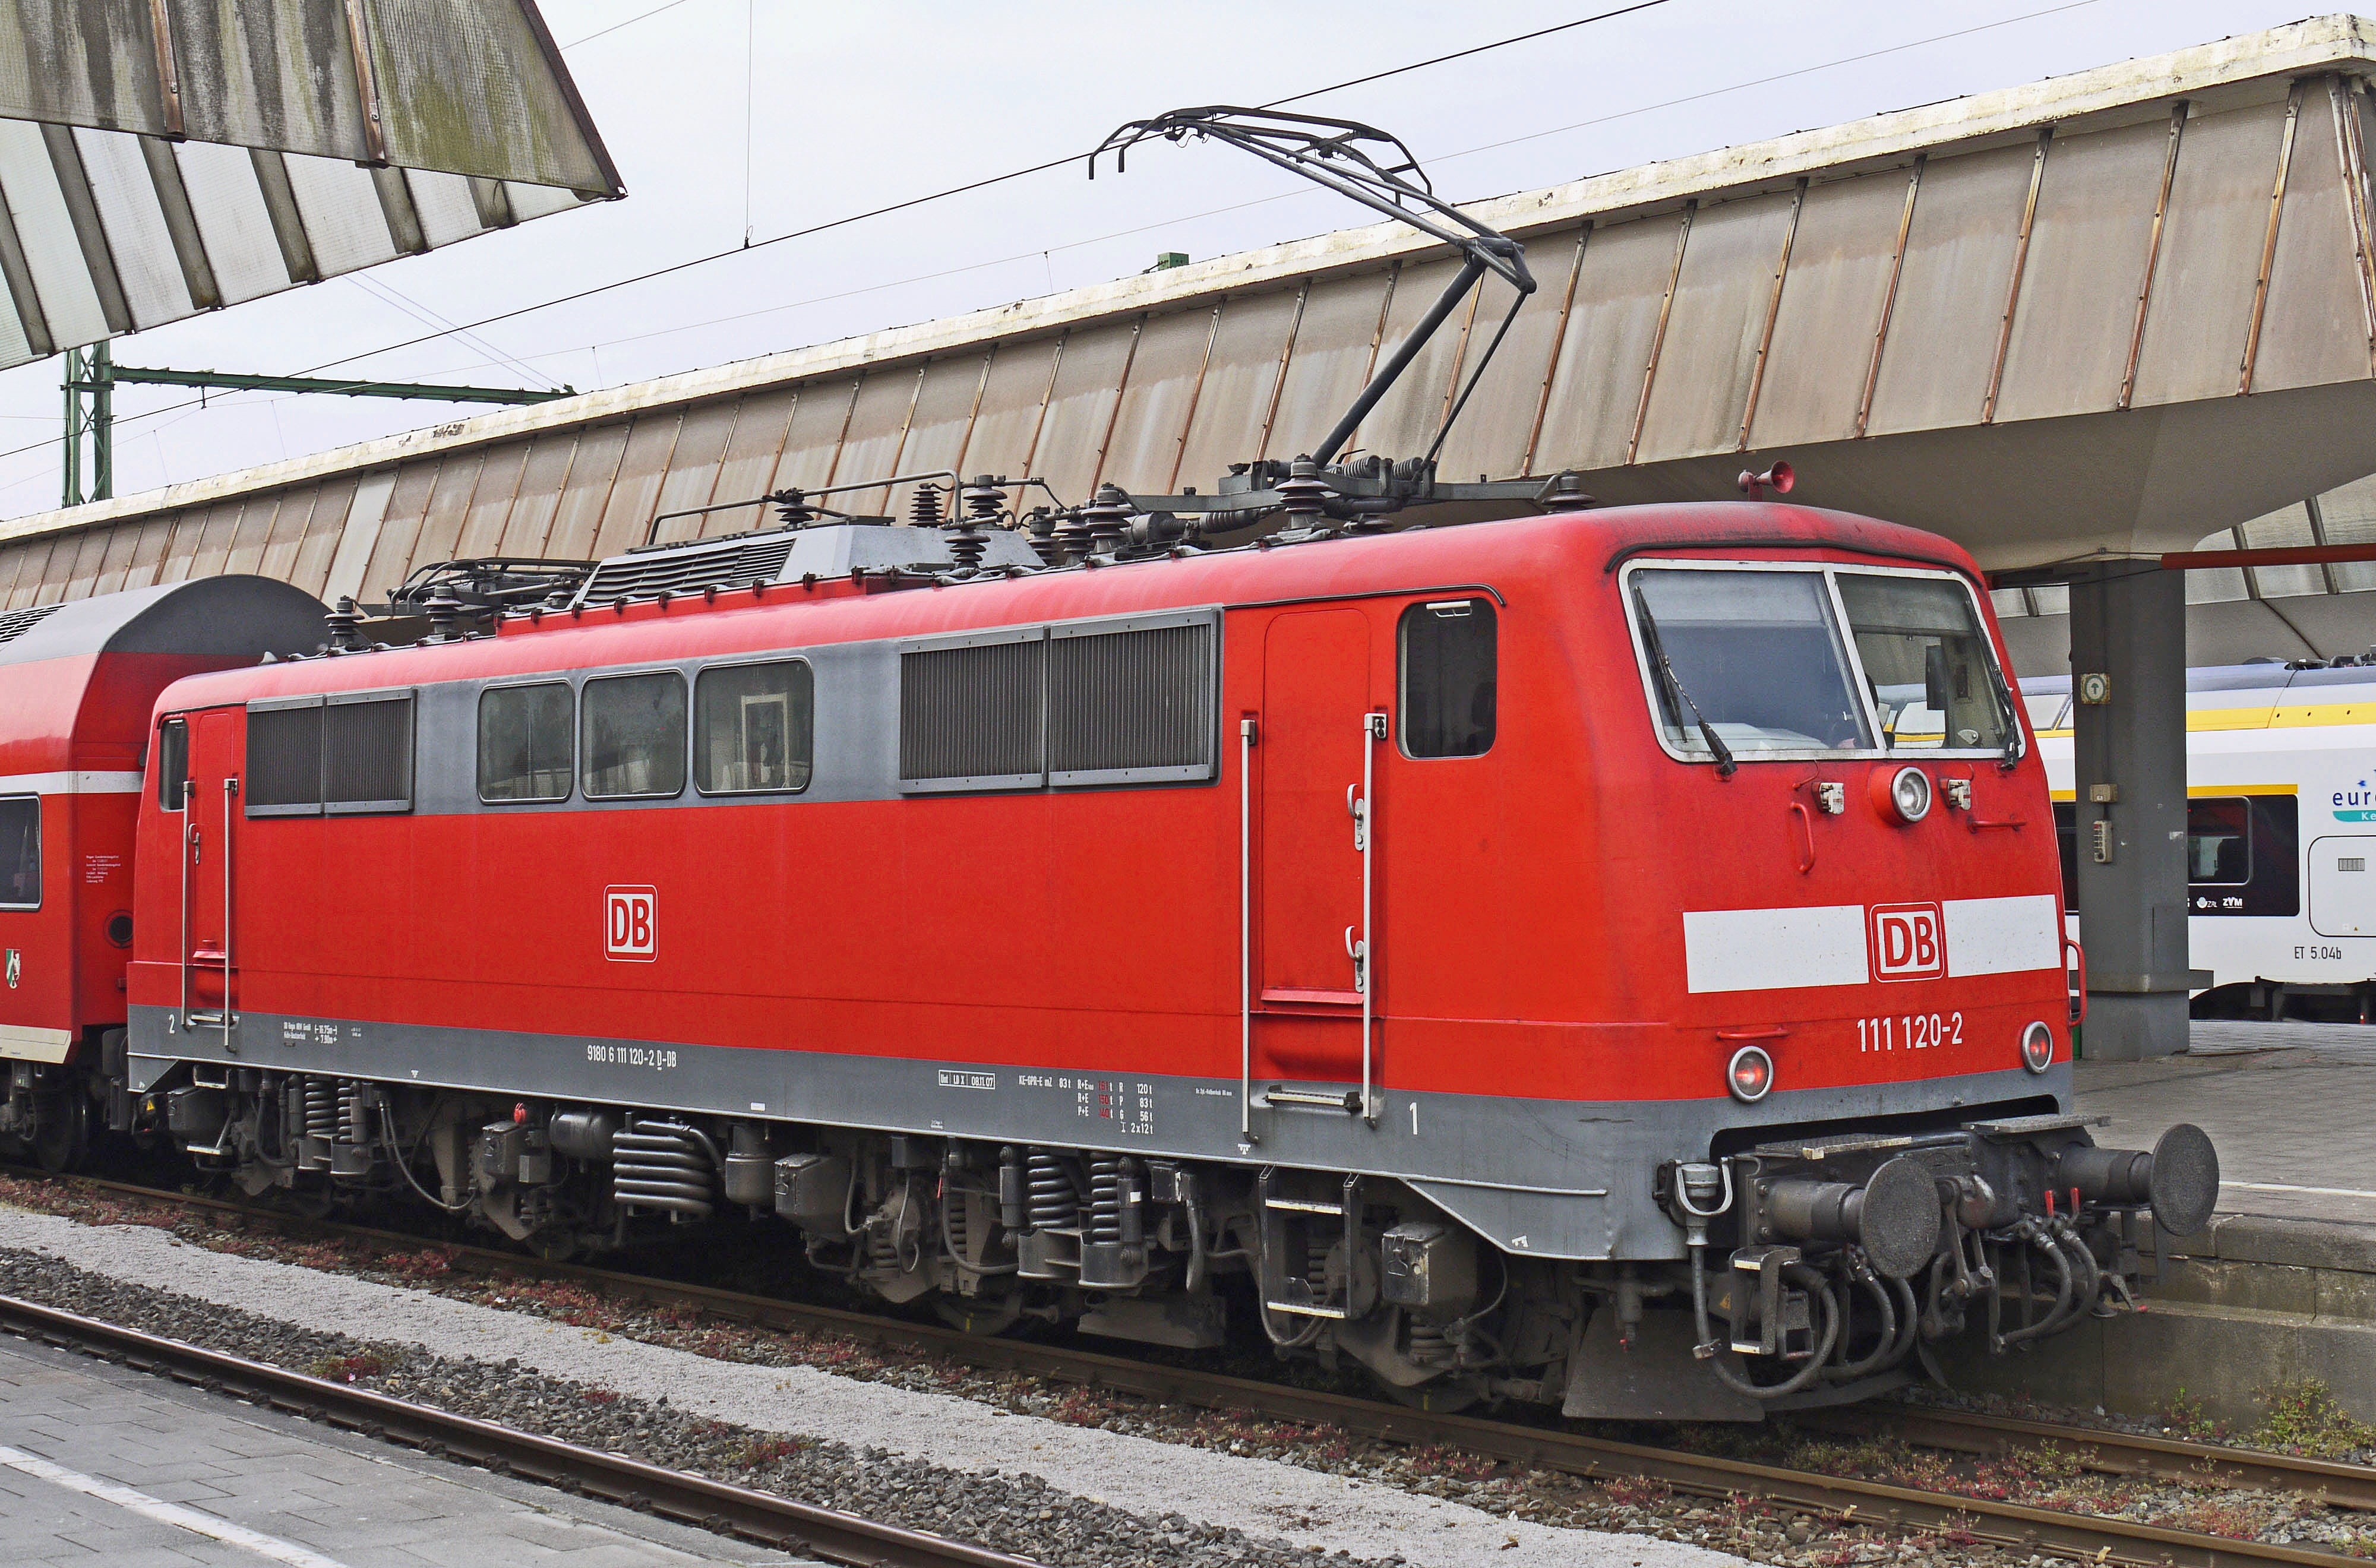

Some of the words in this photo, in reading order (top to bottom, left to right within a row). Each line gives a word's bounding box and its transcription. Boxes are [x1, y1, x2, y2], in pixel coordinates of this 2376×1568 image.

[2333, 791, 2376, 806] eur
[2223, 897, 2243, 906] ZVM
[611, 898, 650, 948] DB
[1882, 916, 1936, 968] DB
[2295, 946, 2305, 959] ET
[2311, 946, 2342, 959] 5.04b
[169, 1014, 175, 1034] 2
[1857, 1017, 1892, 1052] 111
[1903, 1012, 1963, 1049] 120-2
[608, 1047, 614, 1063] 6
[617, 1047, 627, 1063] 111
[629, 1048, 655, 1066] 120-2
[657, 1049, 677, 1070] D-DB
[1119, 1082, 1123, 1093] R
[1137, 1083, 1148, 1094] 120
[1119, 1095, 1123, 1106] P
[1139, 1097, 1148, 1108] 83
[1120, 1109, 1124, 1120] G
[1140, 1111, 1148, 1122] 56
[1409, 1102, 1418, 1135] 1
